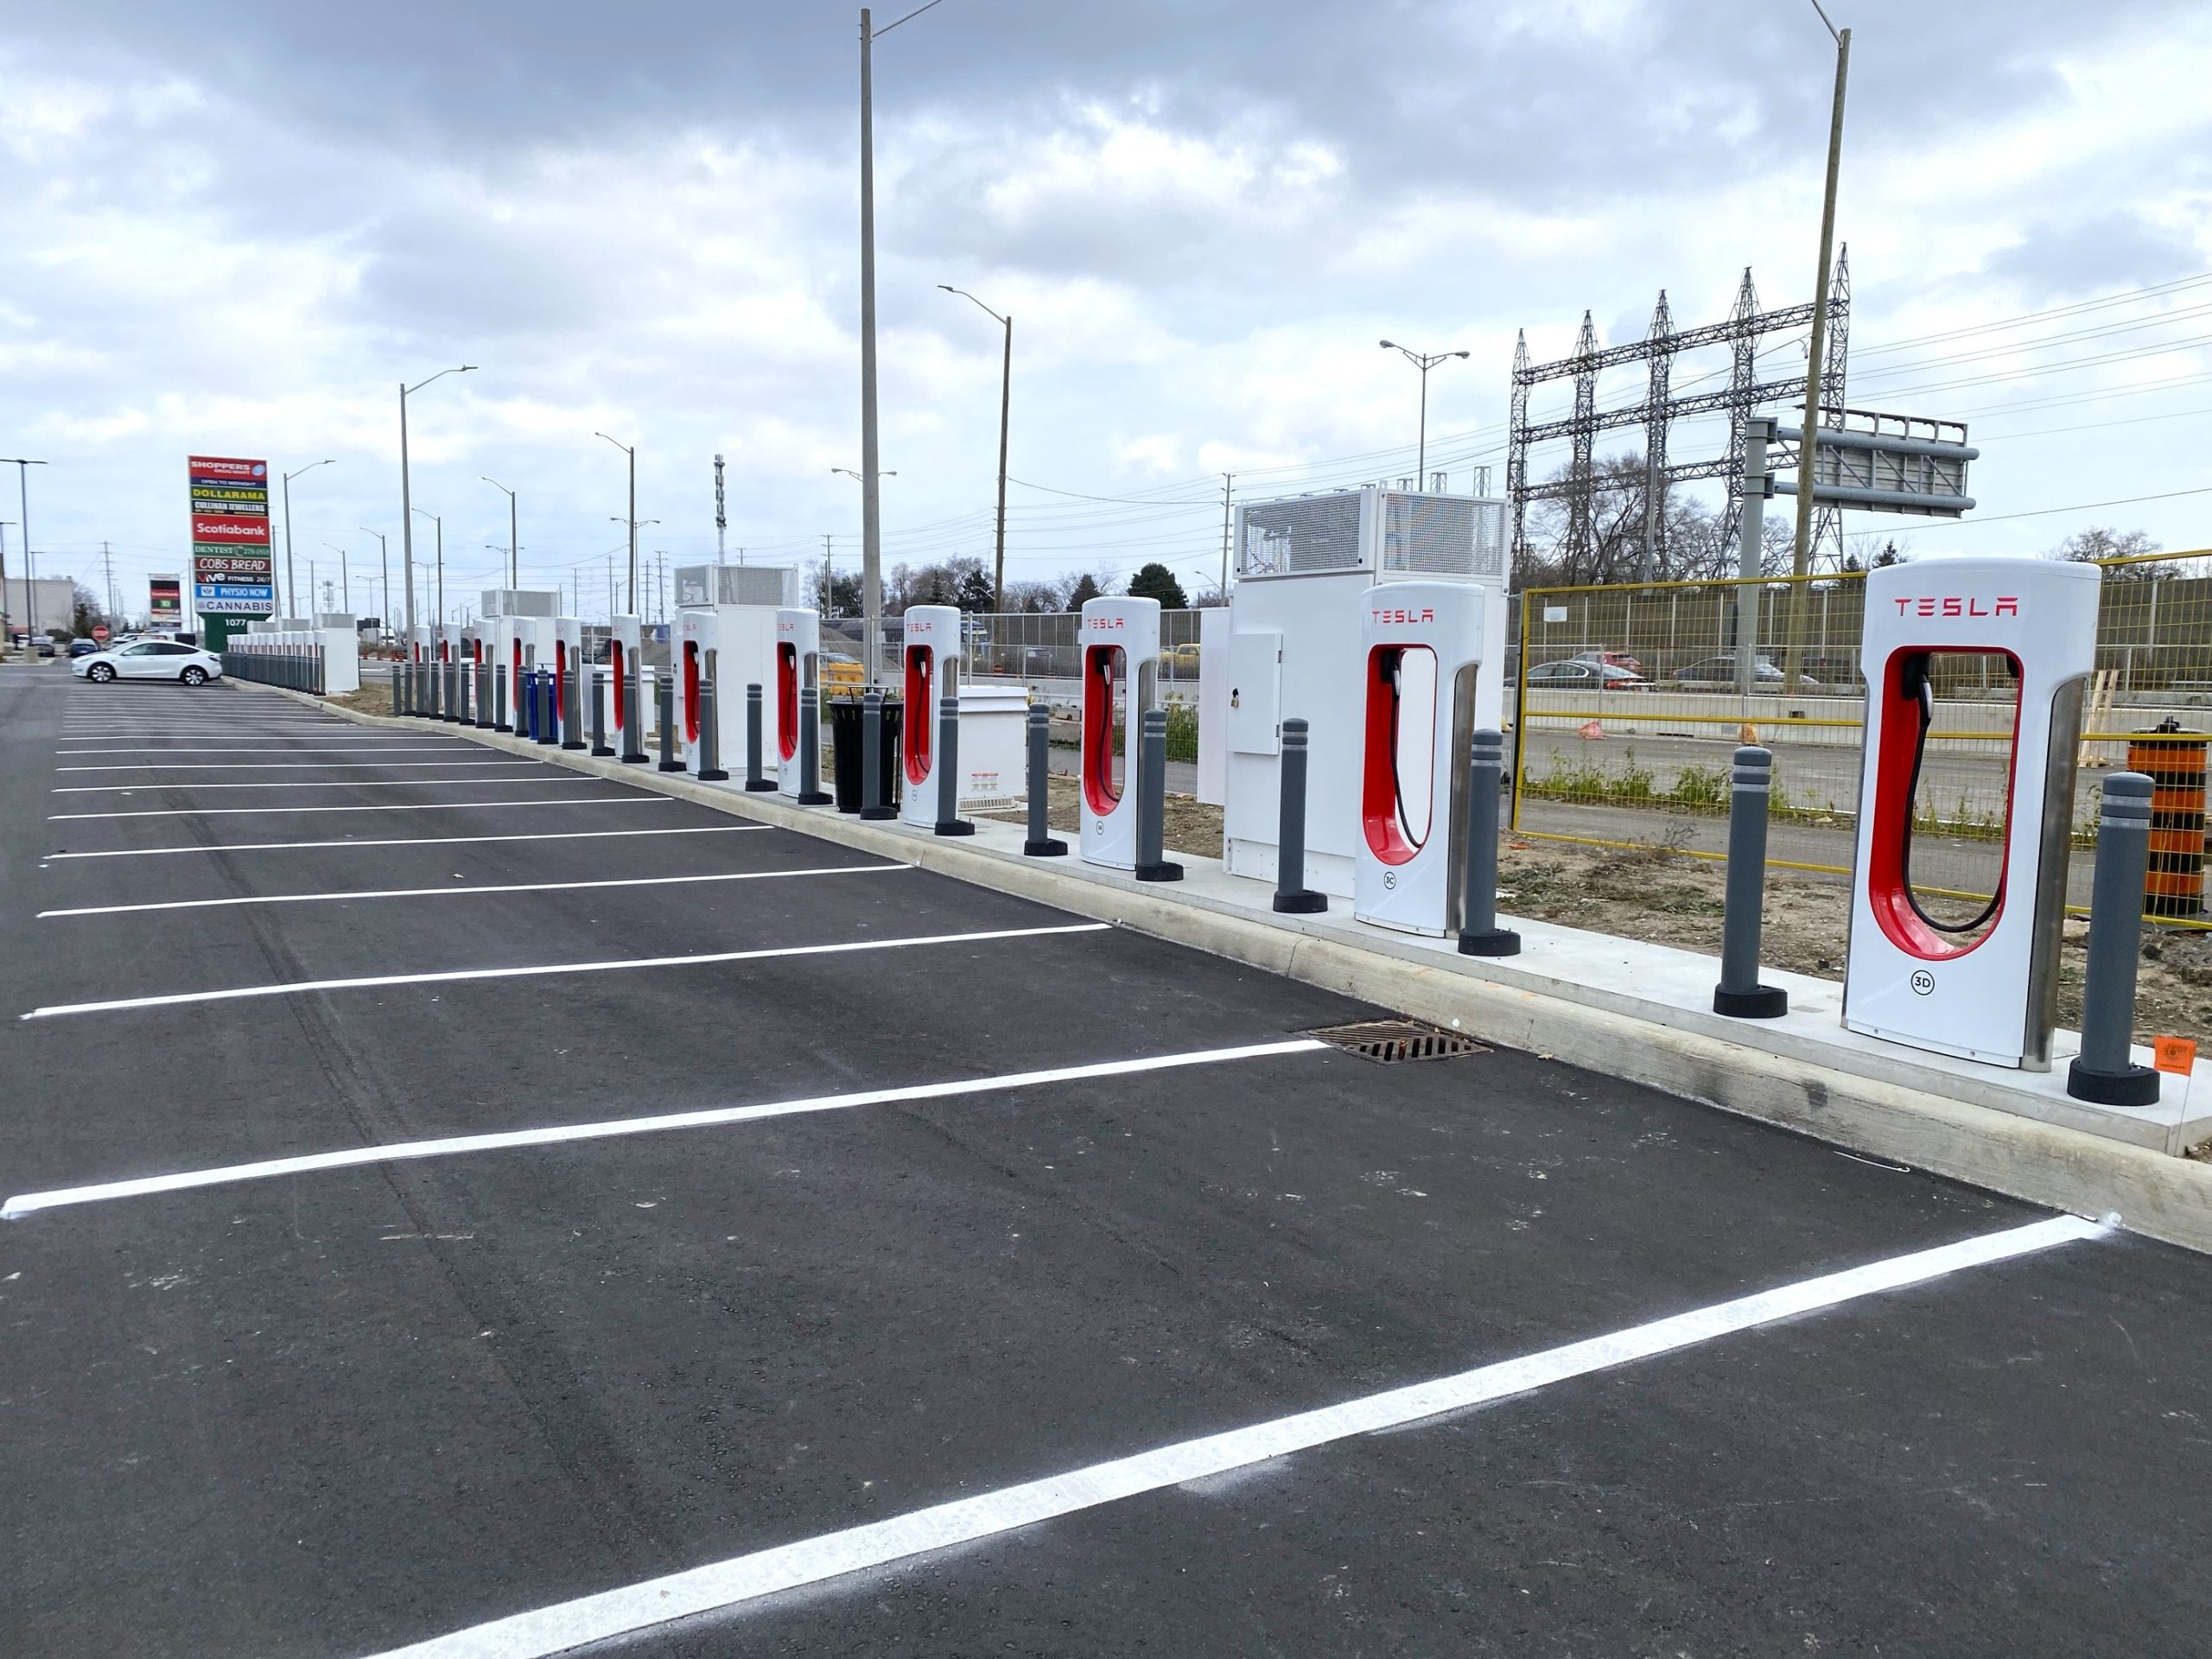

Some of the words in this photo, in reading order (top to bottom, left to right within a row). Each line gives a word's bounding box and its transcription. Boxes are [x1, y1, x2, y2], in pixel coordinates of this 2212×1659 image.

[191, 461, 251, 471] SHOPPERS
[193, 489, 265, 500] DOLLARAMA
[196, 523, 265, 536] Scotiabank
[194, 545, 233, 554] DENTIST
[200, 558, 229, 569] COBS
[231, 559, 265, 570] BREAD
[219, 588, 248, 597] PHYSIO
[249, 588, 268, 597] NOW
[207, 601, 272, 611] CANNABIS
[1894, 597, 2018, 617] TESLA
[1372, 609, 1433, 624] TESLA
[906, 622, 931, 632] TESLA
[1087, 618, 1123, 629] TESLA
[1385, 876, 1395, 885] 3C
[1914, 976, 1931, 988] 3D
